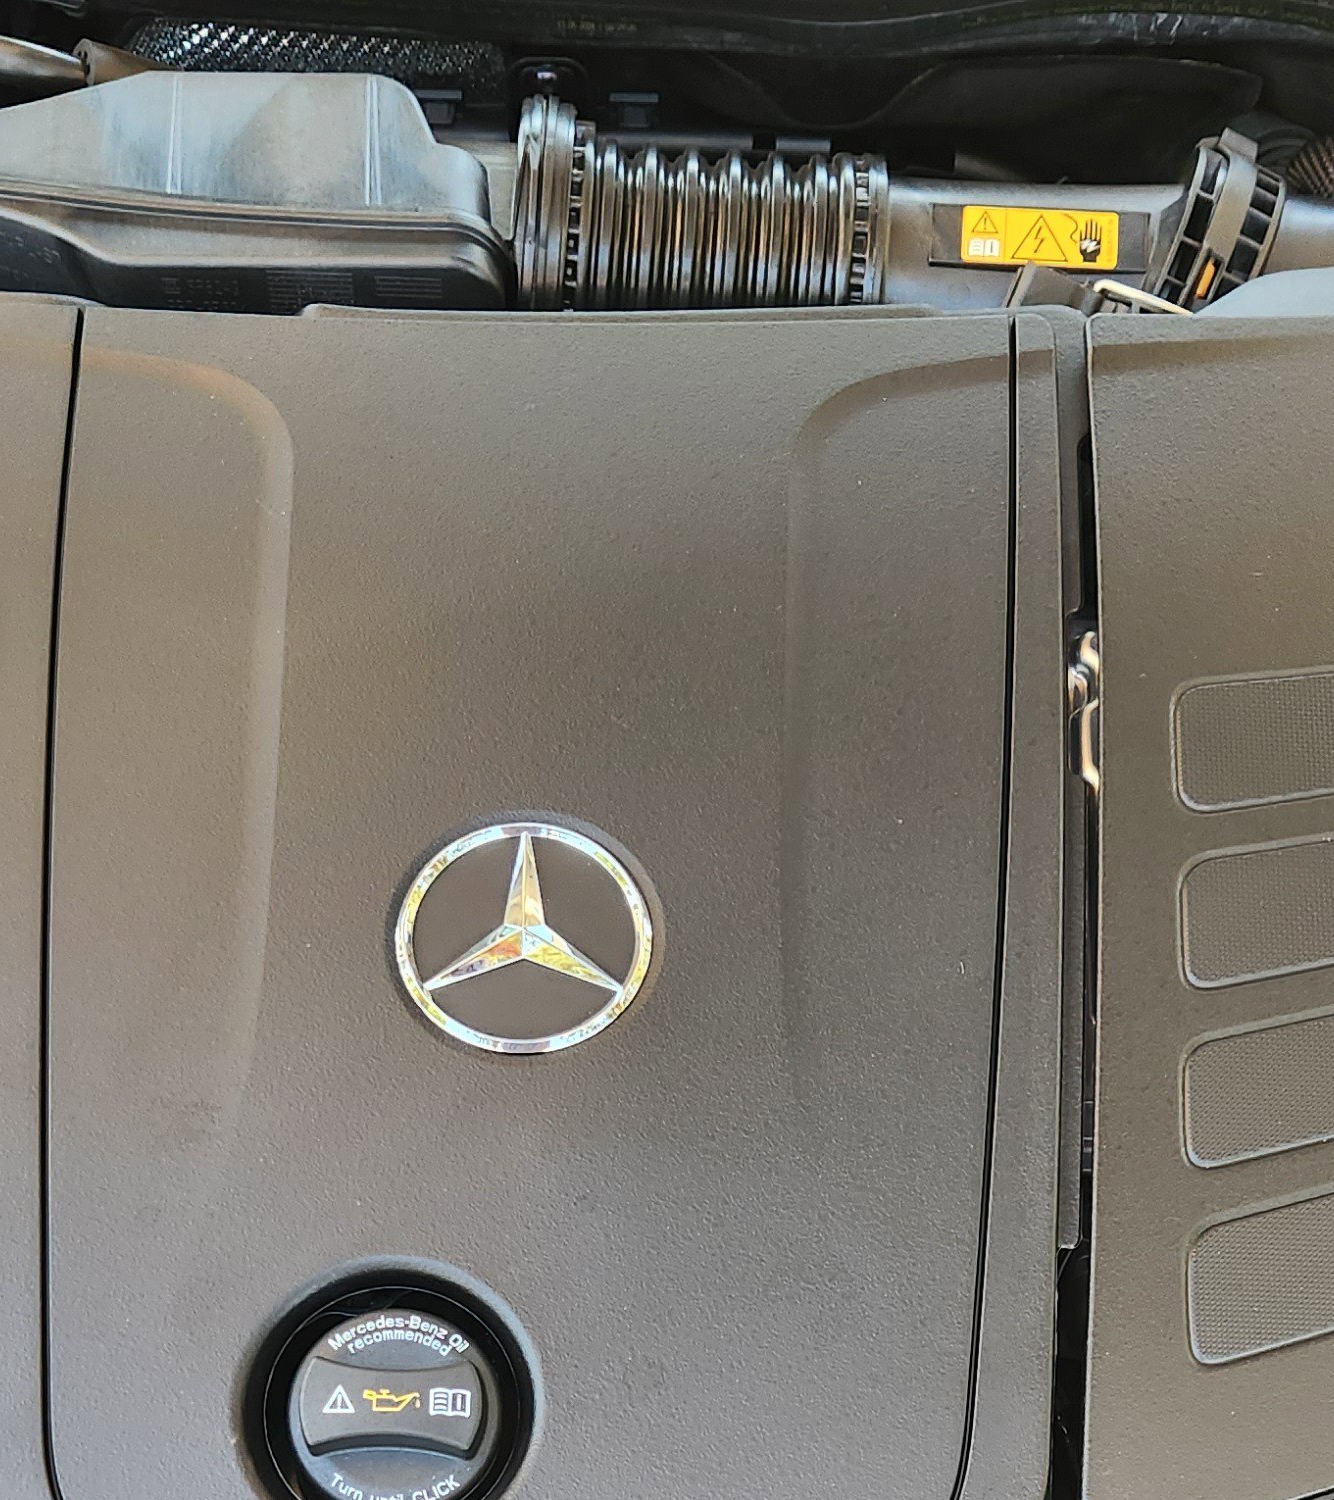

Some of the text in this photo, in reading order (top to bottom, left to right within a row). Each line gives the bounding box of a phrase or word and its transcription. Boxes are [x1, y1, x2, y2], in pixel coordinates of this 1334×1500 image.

[328, 1314, 471, 1354] Mercedes-Benz Oil
[348, 1329, 453, 1357] recommended
